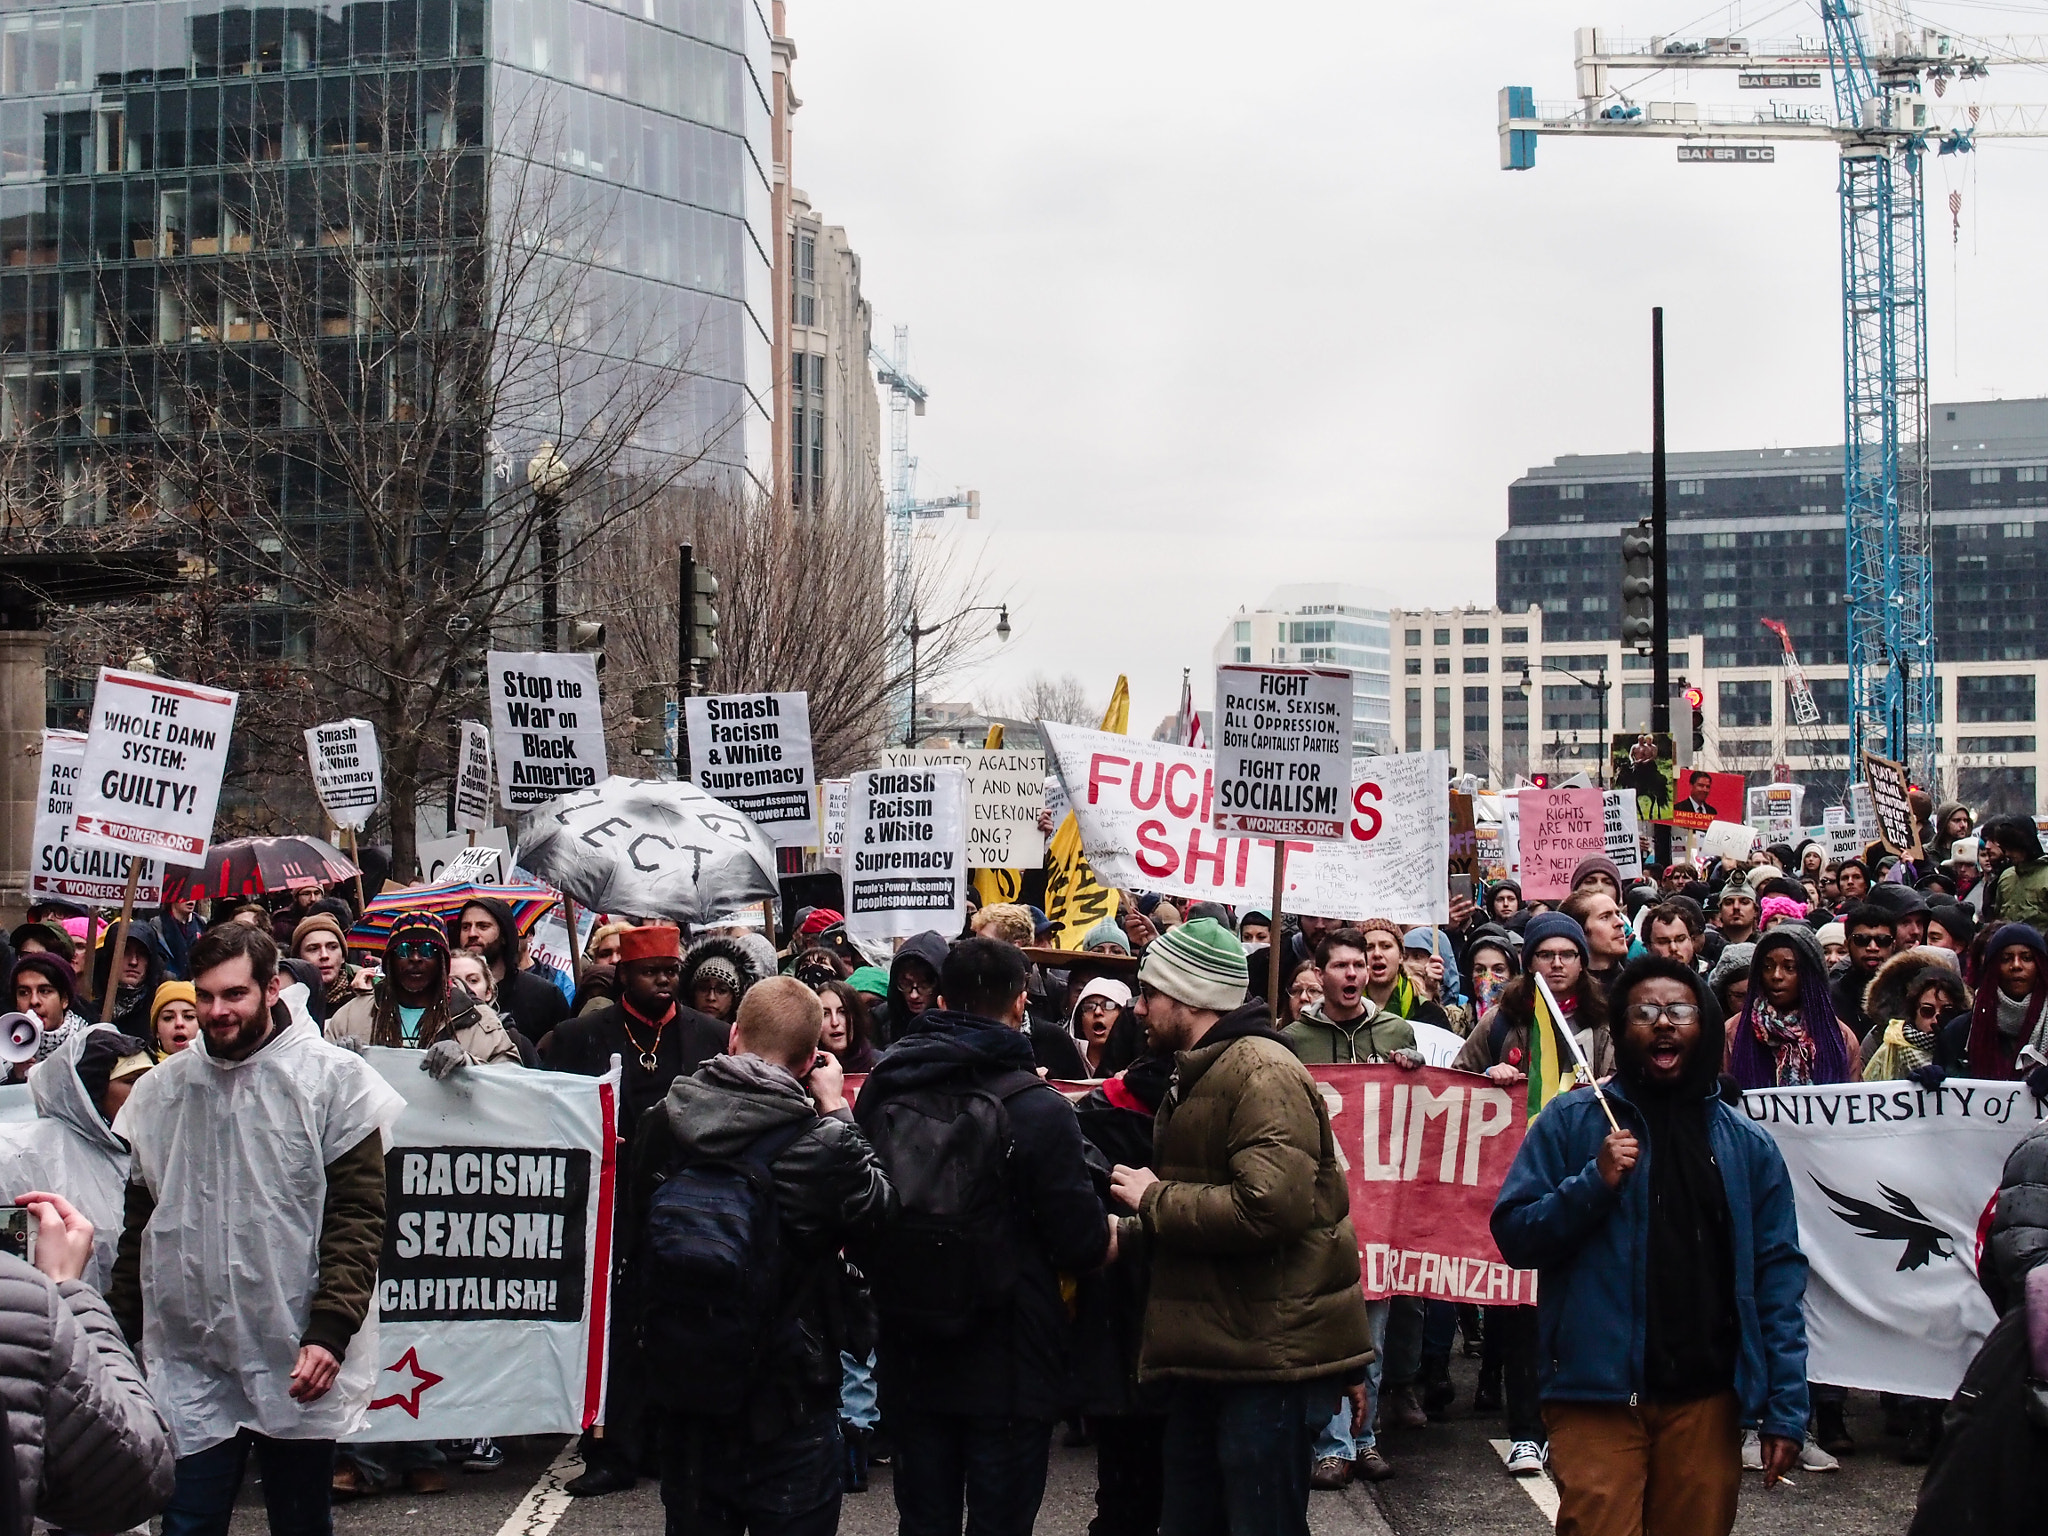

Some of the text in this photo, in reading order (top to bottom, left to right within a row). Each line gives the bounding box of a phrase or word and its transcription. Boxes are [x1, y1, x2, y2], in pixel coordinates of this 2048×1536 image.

[1741, 75, 1820, 86] BAKER DC
[1769, 98, 1834, 122] Turner
[1678, 149, 1774, 160] BAKER DC
[503, 671, 581, 702] Stop the
[1260, 675, 1309, 696] FIGHT
[152, 695, 179, 717] THE
[508, 702, 577, 728] War on
[707, 696, 779, 720] Smash
[1225, 712, 1247, 728] ALL
[105, 712, 216, 750] WHOLE DAMN
[317, 727, 356, 743] Smash
[711, 722, 779, 742] Facism
[320, 743, 357, 757] Facism
[522, 734, 577, 758] Black
[1224, 731, 1339, 753] BOTH CAPITALIST PARTIES
[122, 741, 187, 770] SYSTEM:
[709, 744, 782, 765] & White
[888, 753, 916, 767] YOU
[924, 755, 971, 770] VOTED
[979, 755, 1045, 771] AGAINST
[1950, 754, 2006, 765] HOTEL
[513, 761, 595, 786] America
[701, 768, 804, 789] Supremacy
[1239, 759, 1321, 782] FIGHT FOR
[50, 781, 72, 796] ALL
[102, 770, 198, 814] GUILTY!
[868, 772, 935, 796] Smash
[983, 779, 1011, 795] AND
[1017, 782, 1044, 796] NOW
[739, 799, 764, 808] Power
[766, 794, 806, 806] Assembly
[1221, 779, 1338, 815] SOCIALISM!
[1548, 793, 1572, 806] OUR
[1769, 790, 1790, 798] UNITY
[48, 798, 72, 814] BOTH
[869, 797, 932, 820] Facism
[975, 804, 1041, 821] EVERYONE
[1546, 807, 1584, 820] RIGHTS
[865, 826, 875, 844] &
[879, 821, 933, 842] White
[1245, 817, 1334, 835] WORKERS.ORG
[1538, 821, 1592, 836] ARE NOT
[1831, 829, 1855, 840] TRUMP
[108, 823, 193, 851] WORKERS.ORG
[968, 828, 1012, 844] ONG?
[1534, 837, 1605, 851] UP FOR GRABS
[980, 848, 1009, 863] YOU
[1834, 842, 1856, 852] ABOUT
[454, 849, 498, 866] MAKE
[855, 850, 953, 872] Supremacy
[1315, 862, 1346, 874] GRAB
[1316, 872, 1342, 881] HER
[855, 880, 952, 894] People's Power Assembly
[1550, 873, 1569, 885] ARE
[65, 881, 150, 900] WORKERS.RG
[857, 893, 949, 909] peoplespower.net
[1744, 1087, 2021, 1126] UNIVERSITY of
[402, 1153, 567, 1198] RACISM!
[396, 1210, 565, 1260] SEXISM!
[380, 1277, 557, 1312] CAPITALISM!
